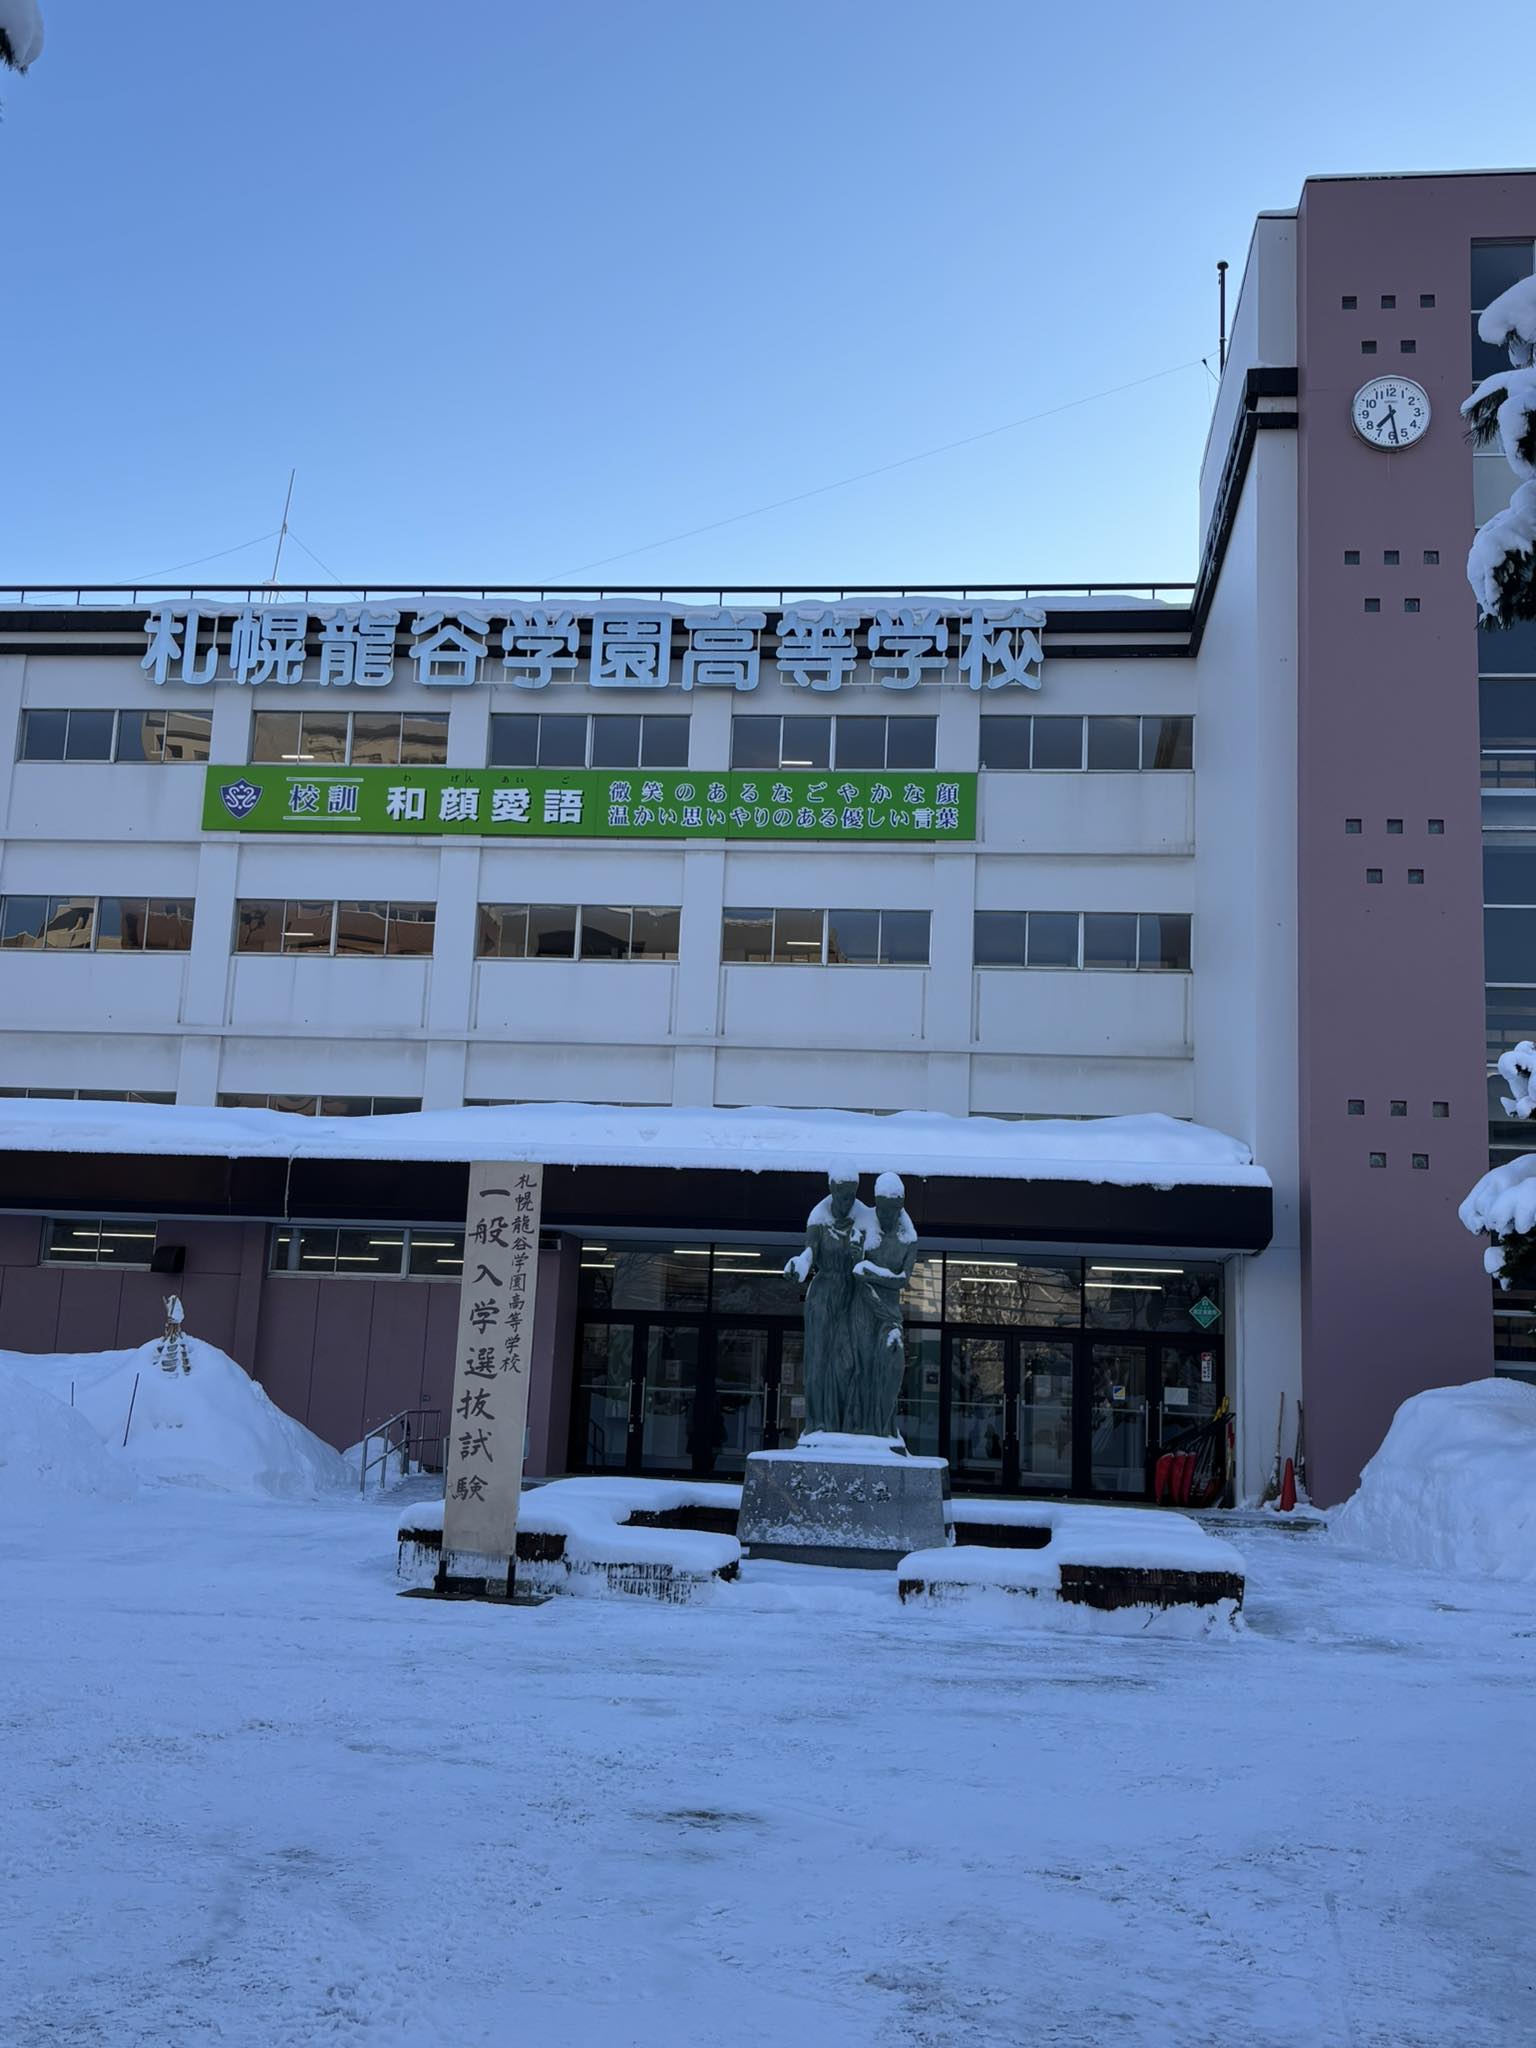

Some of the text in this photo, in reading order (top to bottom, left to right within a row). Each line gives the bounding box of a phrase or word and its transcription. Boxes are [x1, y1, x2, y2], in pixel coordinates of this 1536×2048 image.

[1375, 390, 1383, 400] 11
[1386, 387, 1397, 397] 12
[1401, 389, 1404, 399] 1
[1366, 399, 1377, 409] 10
[1408, 396, 1415, 406] 2
[1362, 410, 1369, 419] 9
[1413, 407, 1421, 417] 3
[1366, 421, 1374, 430] 8
[1410, 420, 1417, 428] 4
[1376, 429, 1383, 438] 7
[1388, 431, 1396, 440] 6
[1400, 428, 1408, 437] 5
[141, 607, 1047, 691] 札幌龍谷学園高等学校
[609, 780, 959, 804] 微笑のあるなごやかな顔
[289, 784, 359, 813] 校訓
[386, 786, 585, 824] 和顔愛語
[608, 805, 959, 829] 温かい思いやりのある優しい言葉
[499, 1173, 537, 1374] 札幌龍谷学園高等学校
[452, 1189, 511, 1502] 一般入学選抜試験
